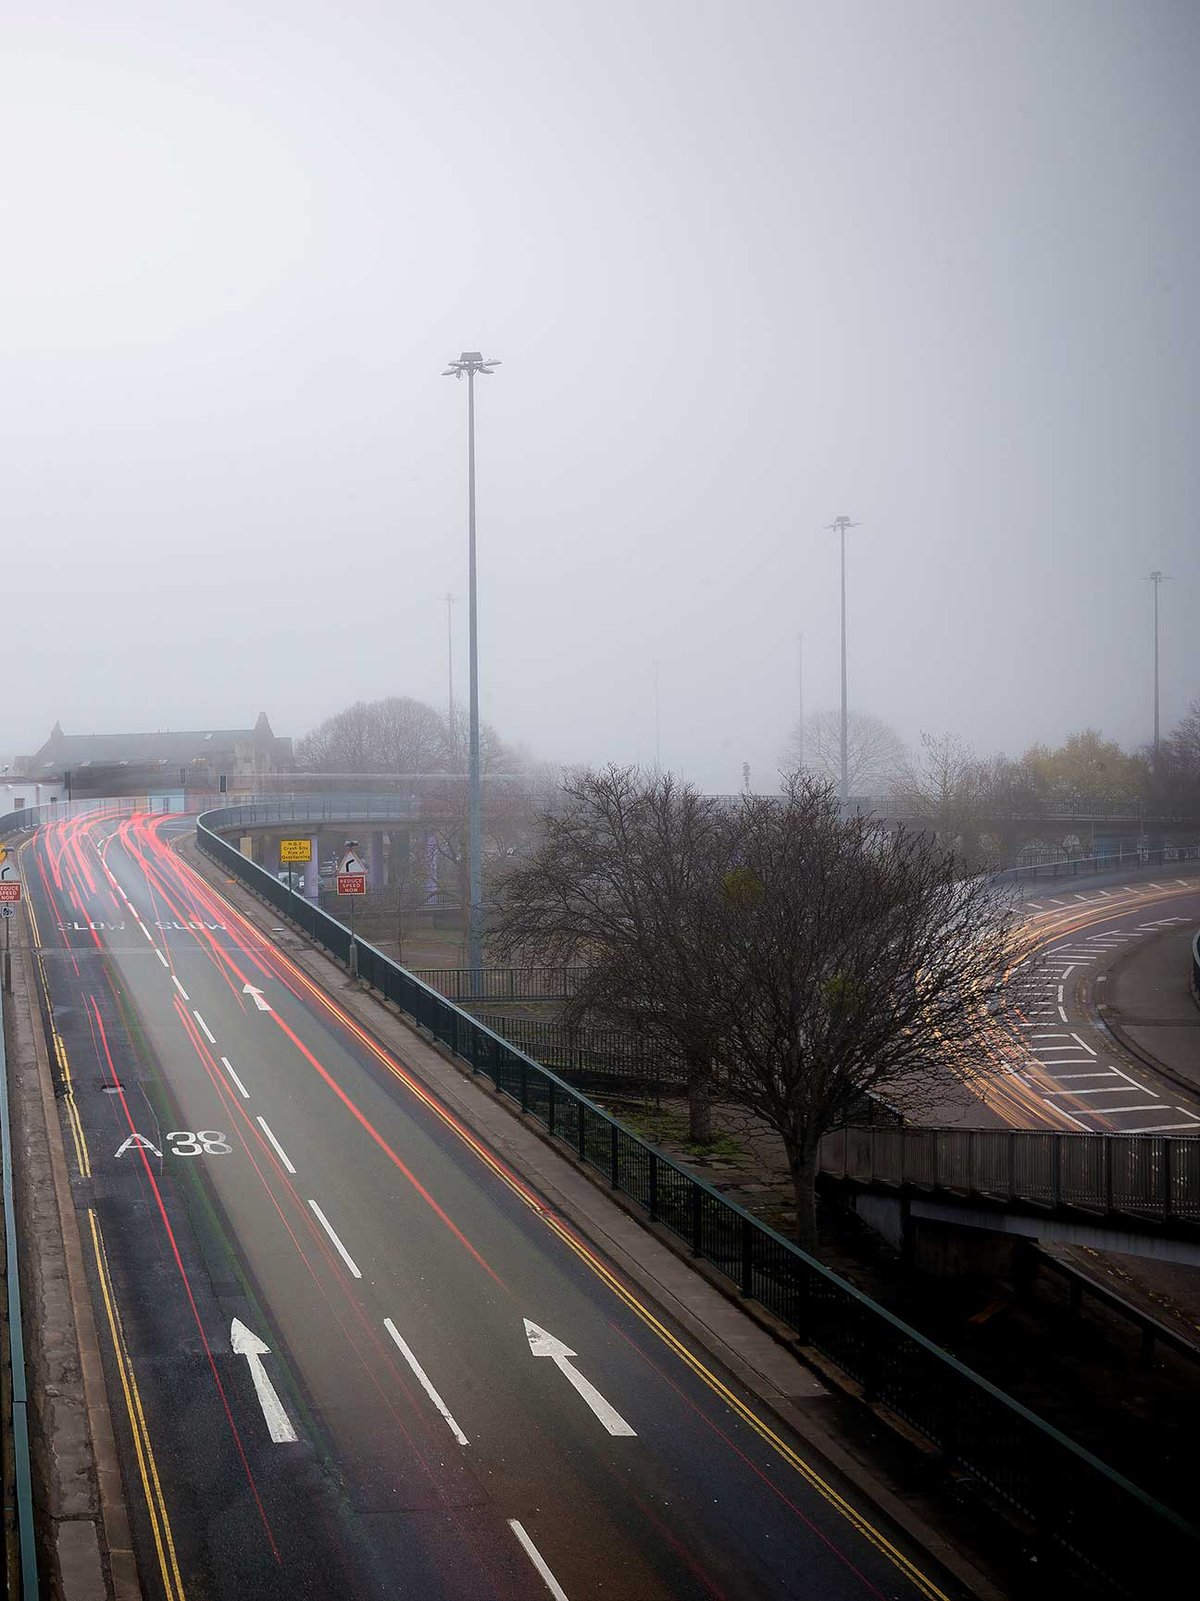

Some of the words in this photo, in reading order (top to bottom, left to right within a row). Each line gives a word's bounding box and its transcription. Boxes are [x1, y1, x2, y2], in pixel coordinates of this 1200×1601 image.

[57, 921, 126, 931] SLOW
[154, 921, 227, 930] SLOW
[114, 1130, 233, 1158] A38
